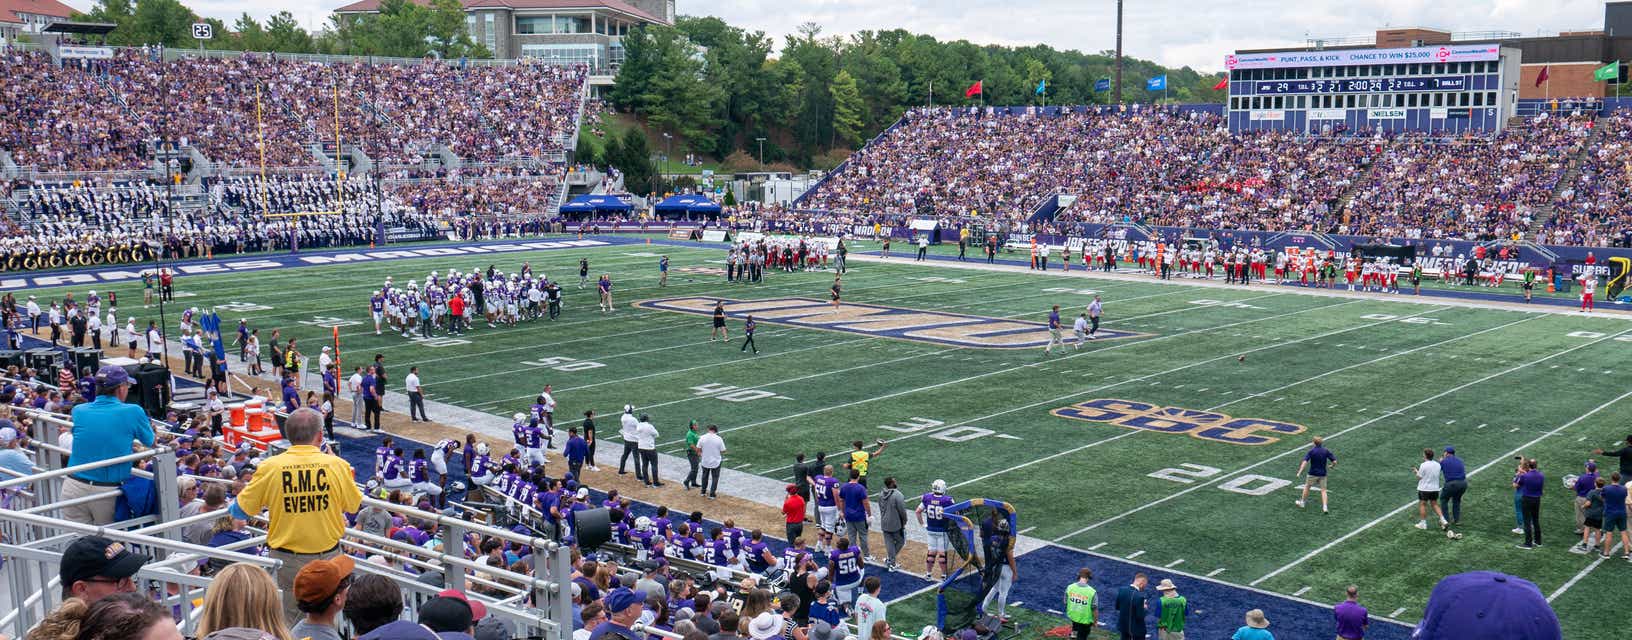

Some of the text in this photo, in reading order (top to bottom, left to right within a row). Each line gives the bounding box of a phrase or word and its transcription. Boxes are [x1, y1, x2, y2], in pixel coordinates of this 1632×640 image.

[195, 25, 209, 37] 25
[1277, 83, 1288, 92] 29
[300, 239, 611, 264] MADISON
[877, 416, 996, 443] 30
[282, 468, 330, 494] R.M.C.
[1147, 462, 1293, 497] 20
[284, 494, 329, 513] EVENTS
[838, 558, 857, 575] 50
